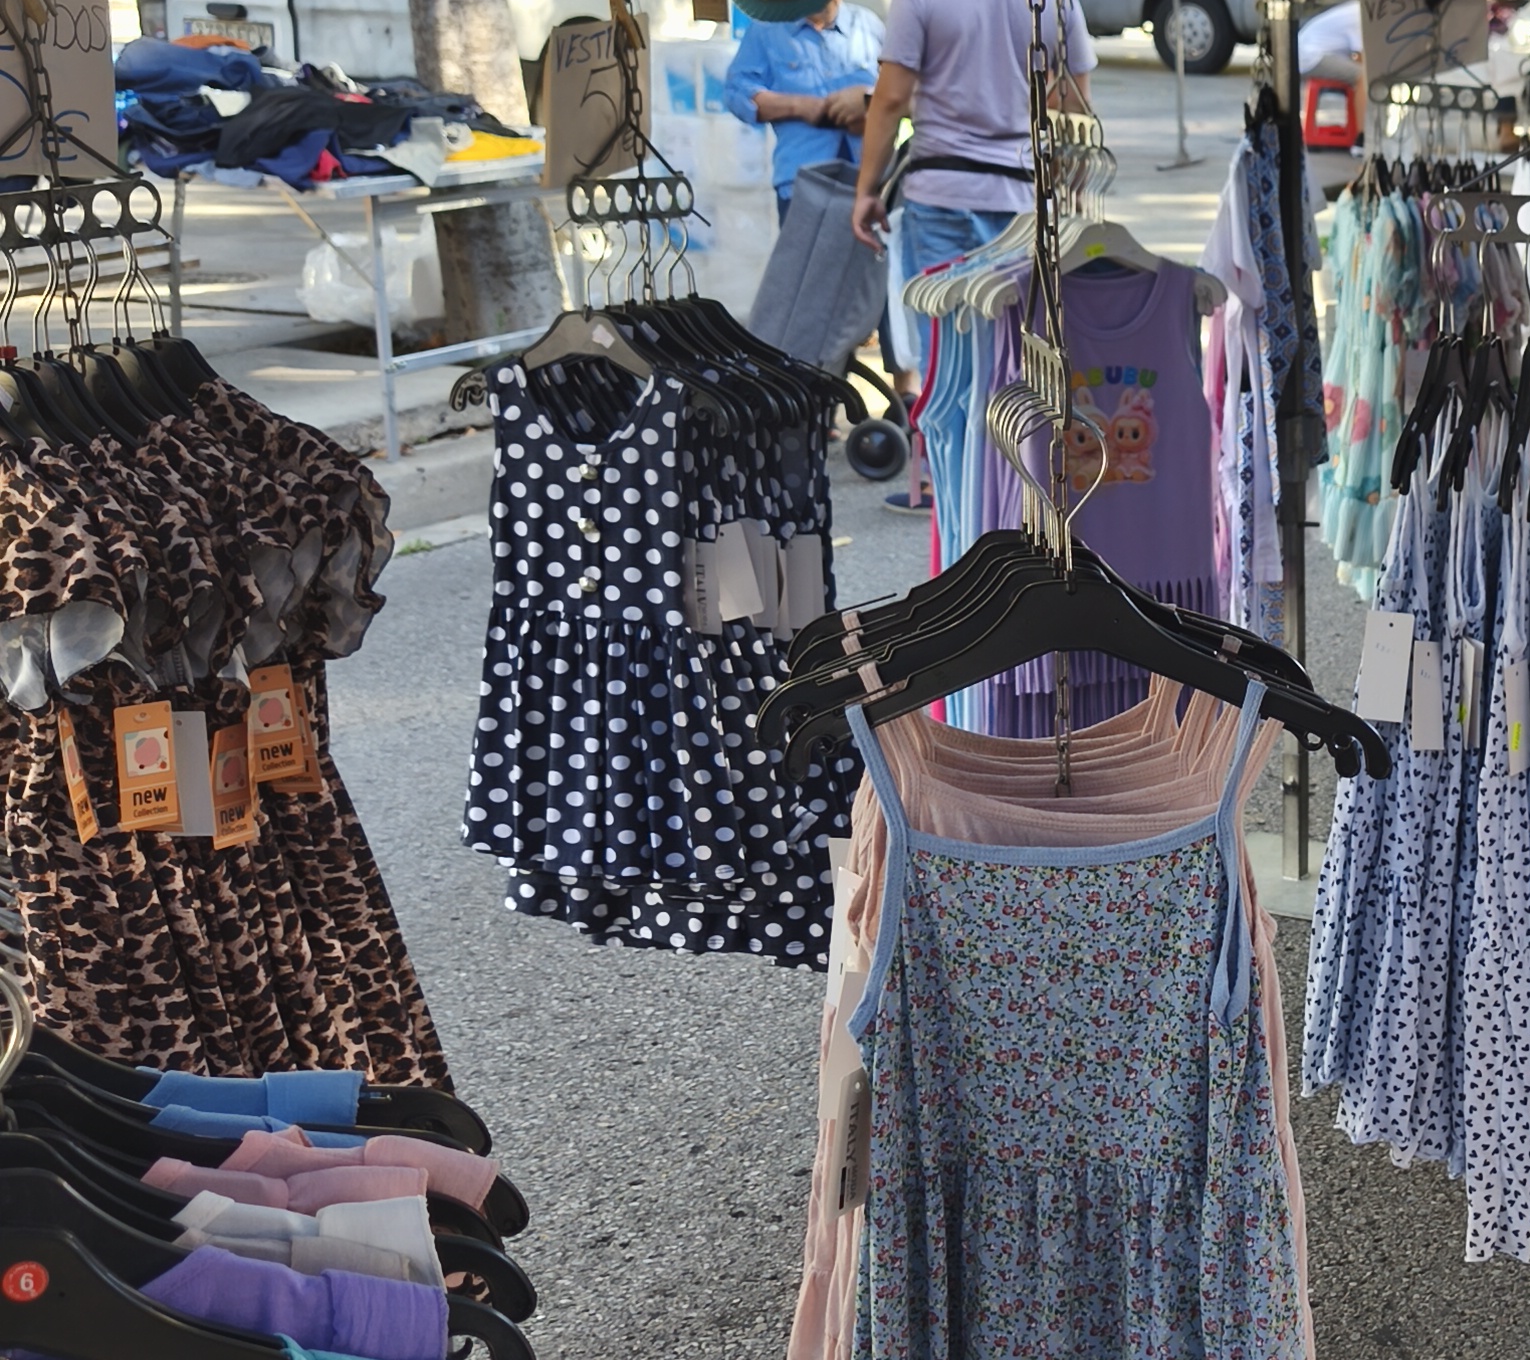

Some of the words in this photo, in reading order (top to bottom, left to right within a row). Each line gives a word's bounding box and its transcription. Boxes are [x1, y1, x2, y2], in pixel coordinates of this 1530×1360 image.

[260, 741, 294, 761] new
[262, 759, 297, 772] Collection
[133, 786, 168, 807] new
[133, 806, 169, 818] Collection
[220, 805, 246, 825] new
[846, 1101, 860, 1163] ITALY
[20, 1272, 34, 1292] 6
